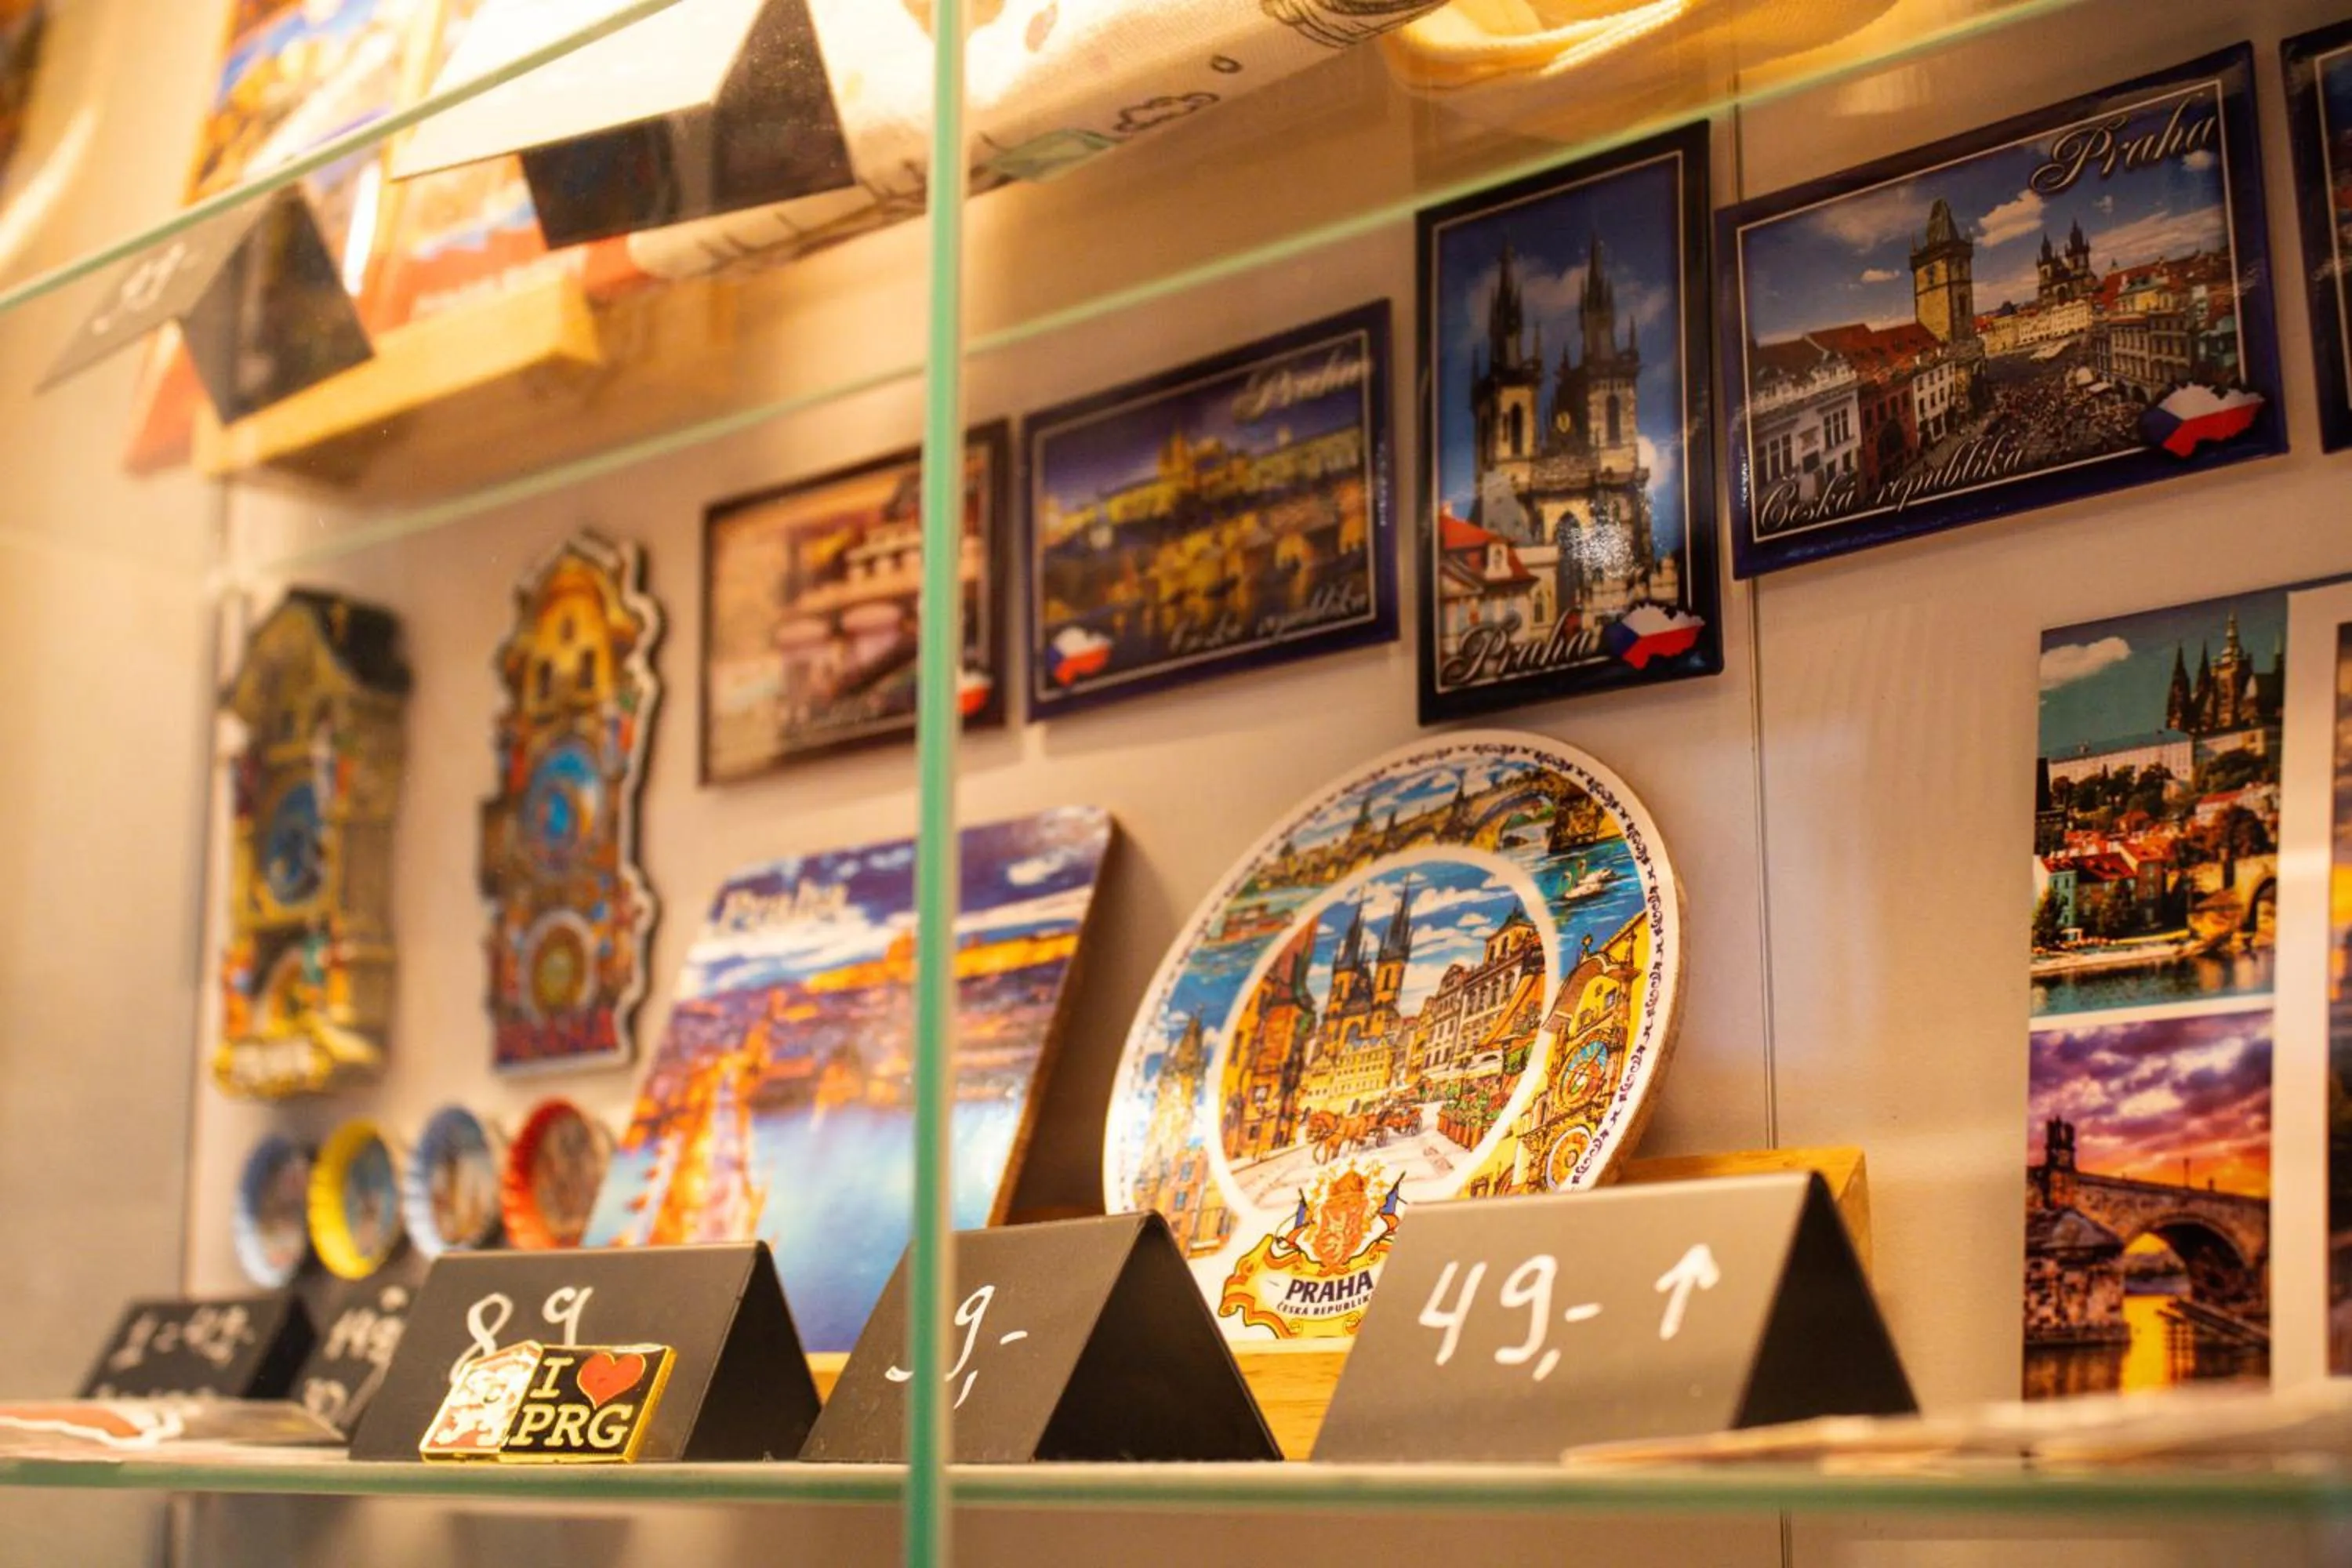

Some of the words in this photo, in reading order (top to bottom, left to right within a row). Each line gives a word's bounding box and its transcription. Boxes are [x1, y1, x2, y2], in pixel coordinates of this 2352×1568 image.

[2031, 96, 2216, 194] Praha
[1761, 472, 1856, 529] Česká
[1876, 436, 2024, 513] republika
[1443, 606, 1591, 684] Praha
[1285, 1270, 1374, 1303] PRAHA
[1312, 1294, 1370, 1316] REPUBLIK
[529, 1357, 575, 1399] I
[509, 1403, 633, 1448] PRG
